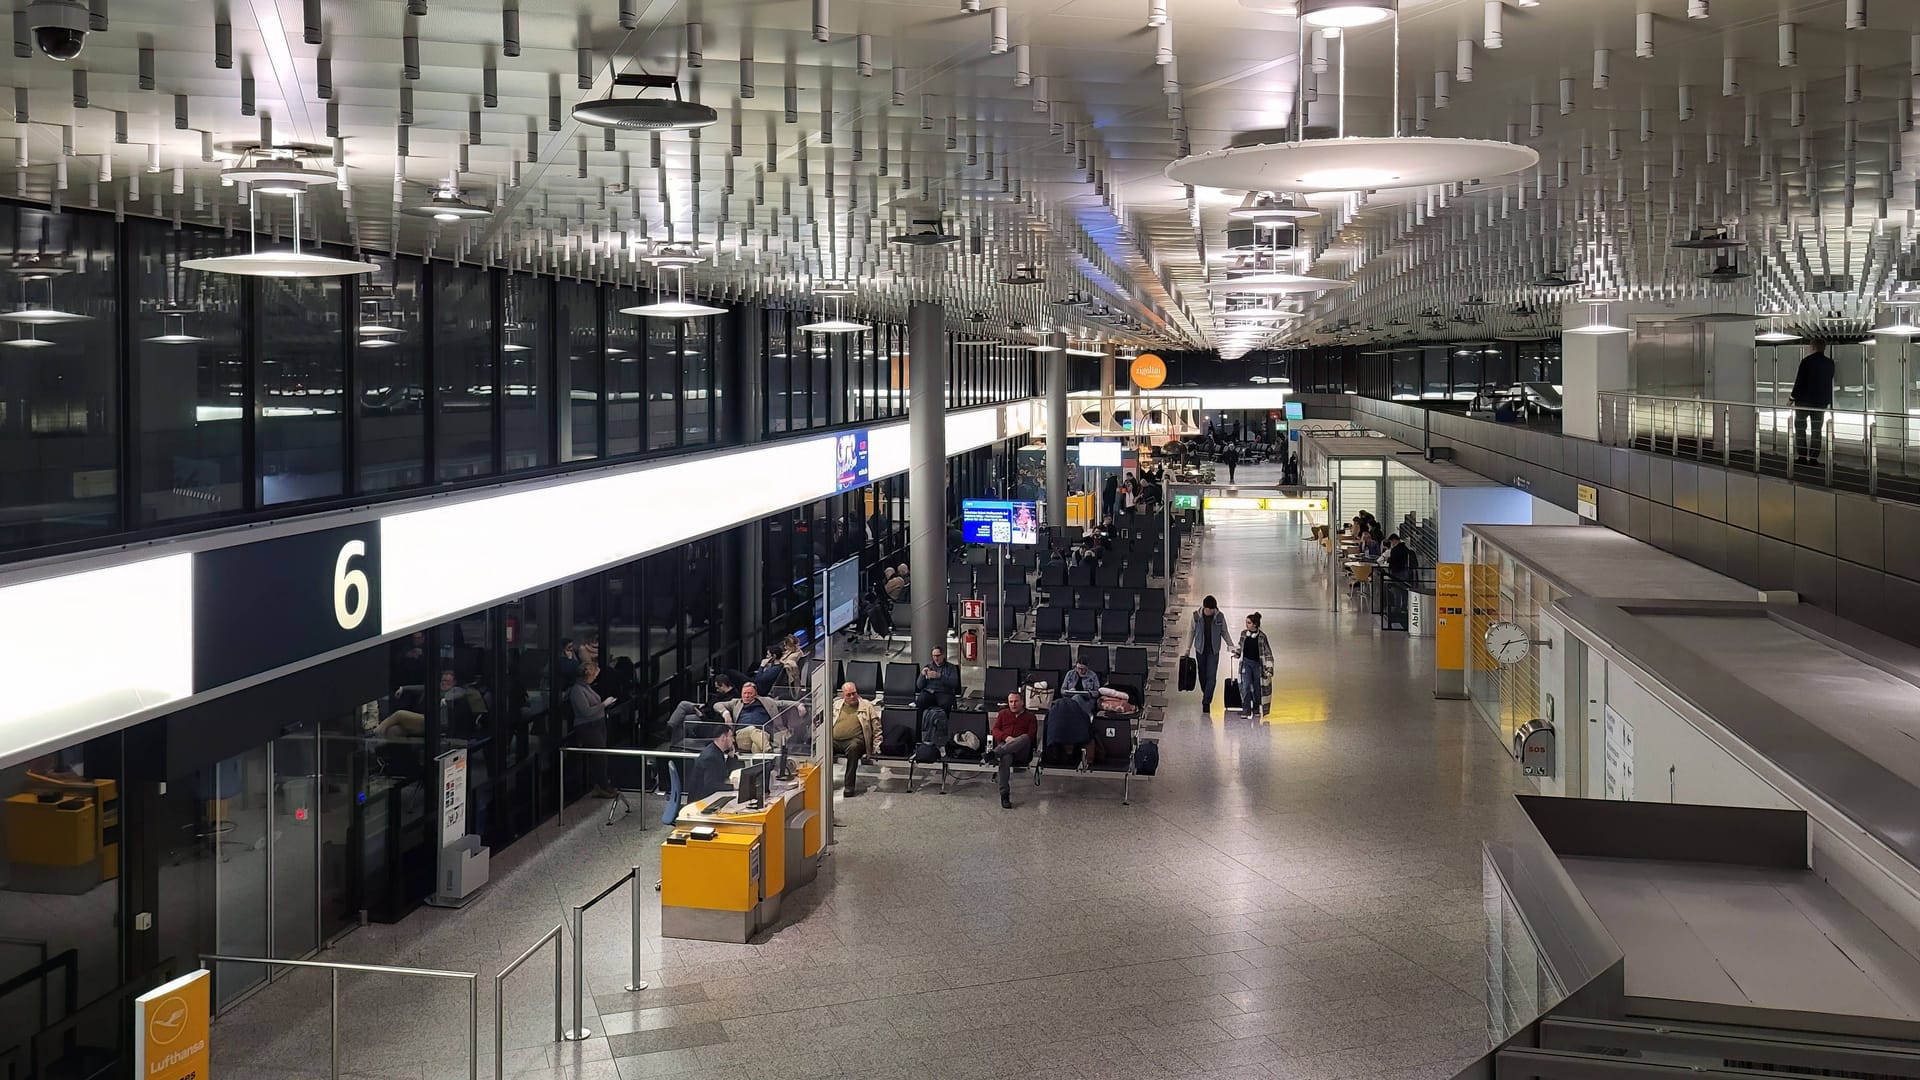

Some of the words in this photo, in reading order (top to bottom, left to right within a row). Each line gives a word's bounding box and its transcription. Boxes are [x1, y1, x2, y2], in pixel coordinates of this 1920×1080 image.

[334, 540, 369, 630] 6
[1411, 602, 1419, 627] Abfall
[150, 1039, 205, 1075] Lufthansa
